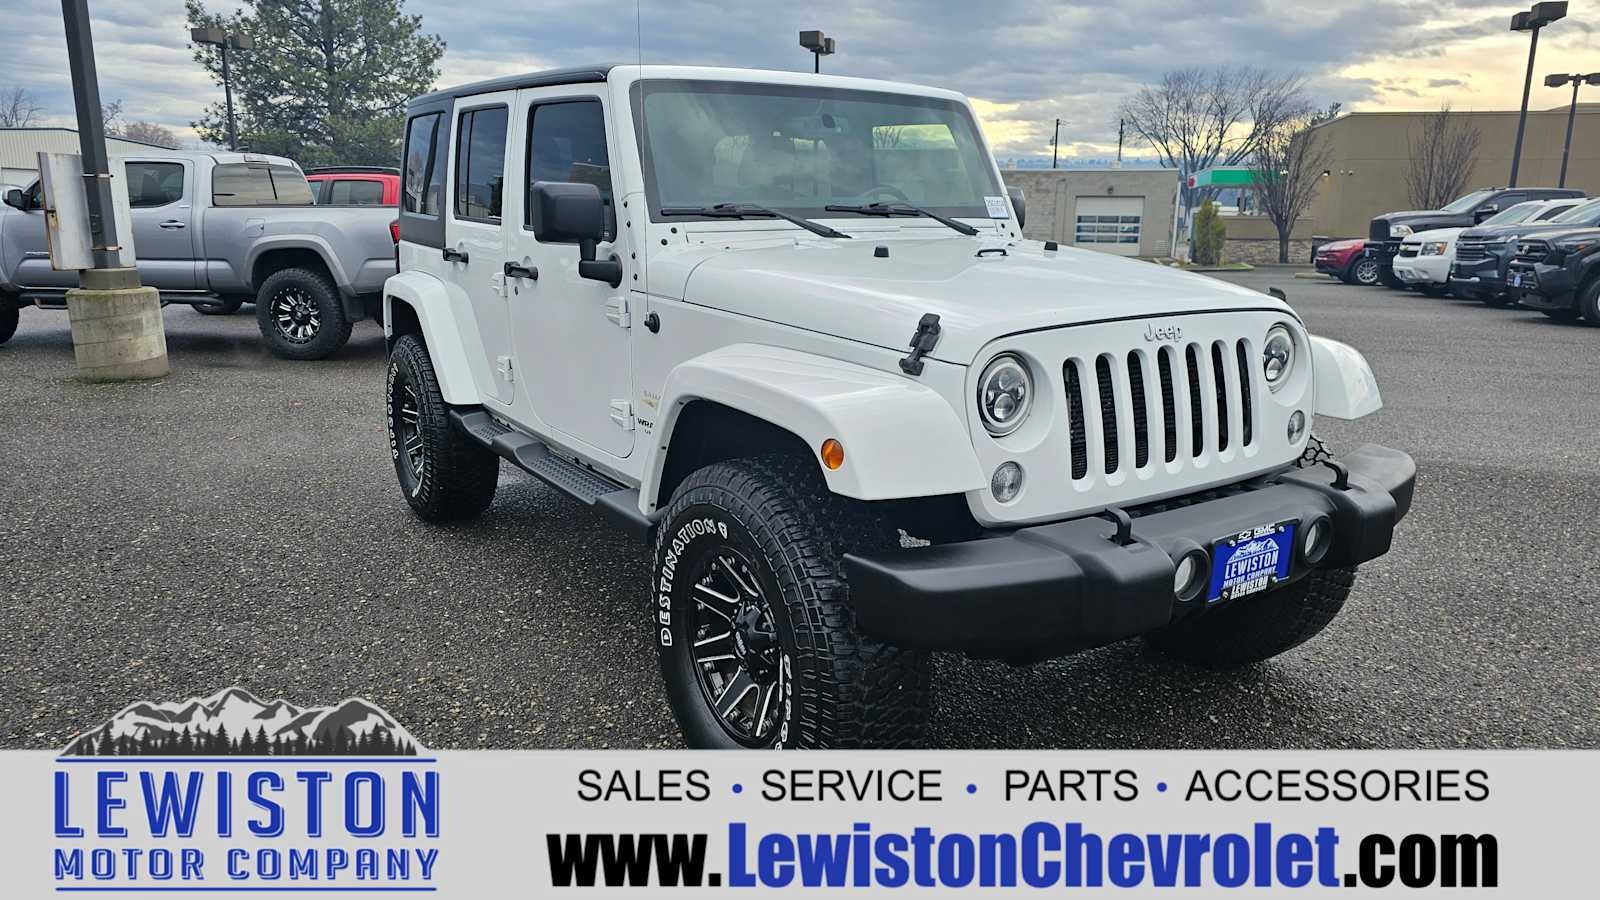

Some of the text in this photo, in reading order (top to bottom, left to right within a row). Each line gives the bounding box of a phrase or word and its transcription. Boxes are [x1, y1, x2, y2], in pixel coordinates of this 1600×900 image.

[1143, 321, 1182, 343] Jeep
[1253, 523, 1276, 537] GMC
[1224, 550, 1279, 580] LEWISTON
[659, 518, 717, 647] DESTINATION
[1223, 565, 1277, 589] MOTOR COMPANY
[1231, 576, 1269, 595] LEWISTON
